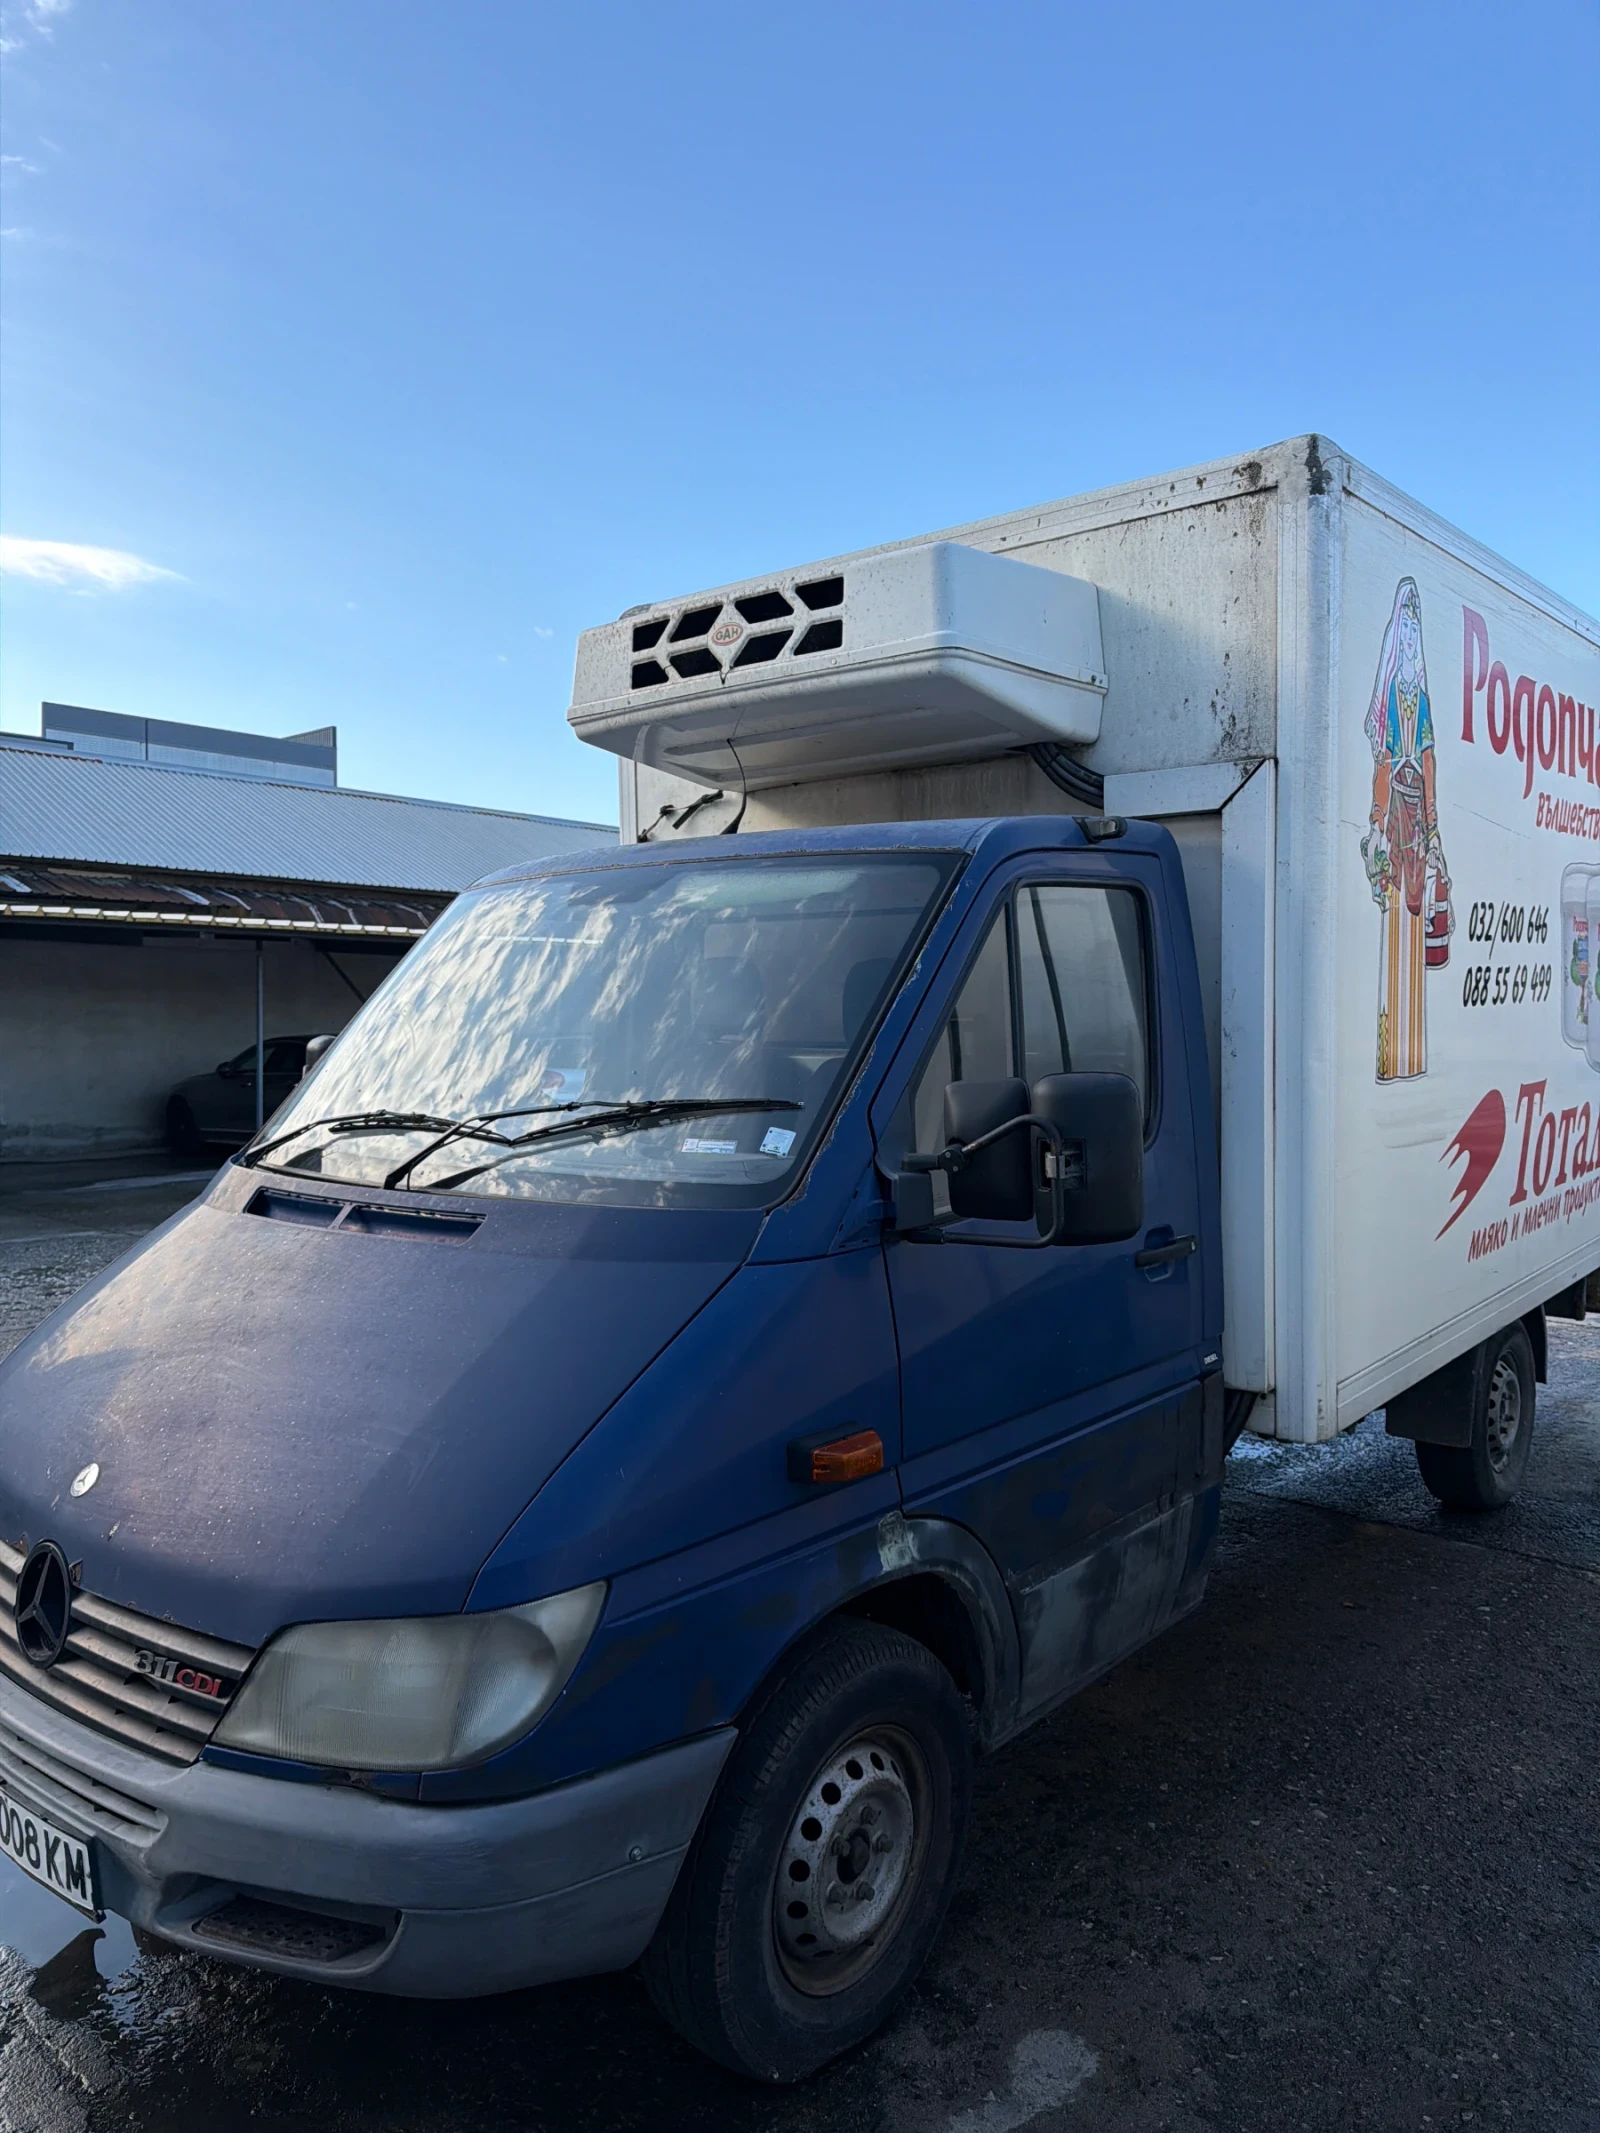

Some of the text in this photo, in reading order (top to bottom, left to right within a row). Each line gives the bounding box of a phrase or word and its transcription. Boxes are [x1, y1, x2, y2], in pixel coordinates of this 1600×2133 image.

[715, 626, 738, 641] GAH
[1468, 900, 1549, 960] 032/600 646
[1463, 965, 1491, 1007] 088
[1492, 966, 1511, 1005] 55
[1512, 964, 1528, 1004] 69
[1530, 962, 1552, 1003] 499
